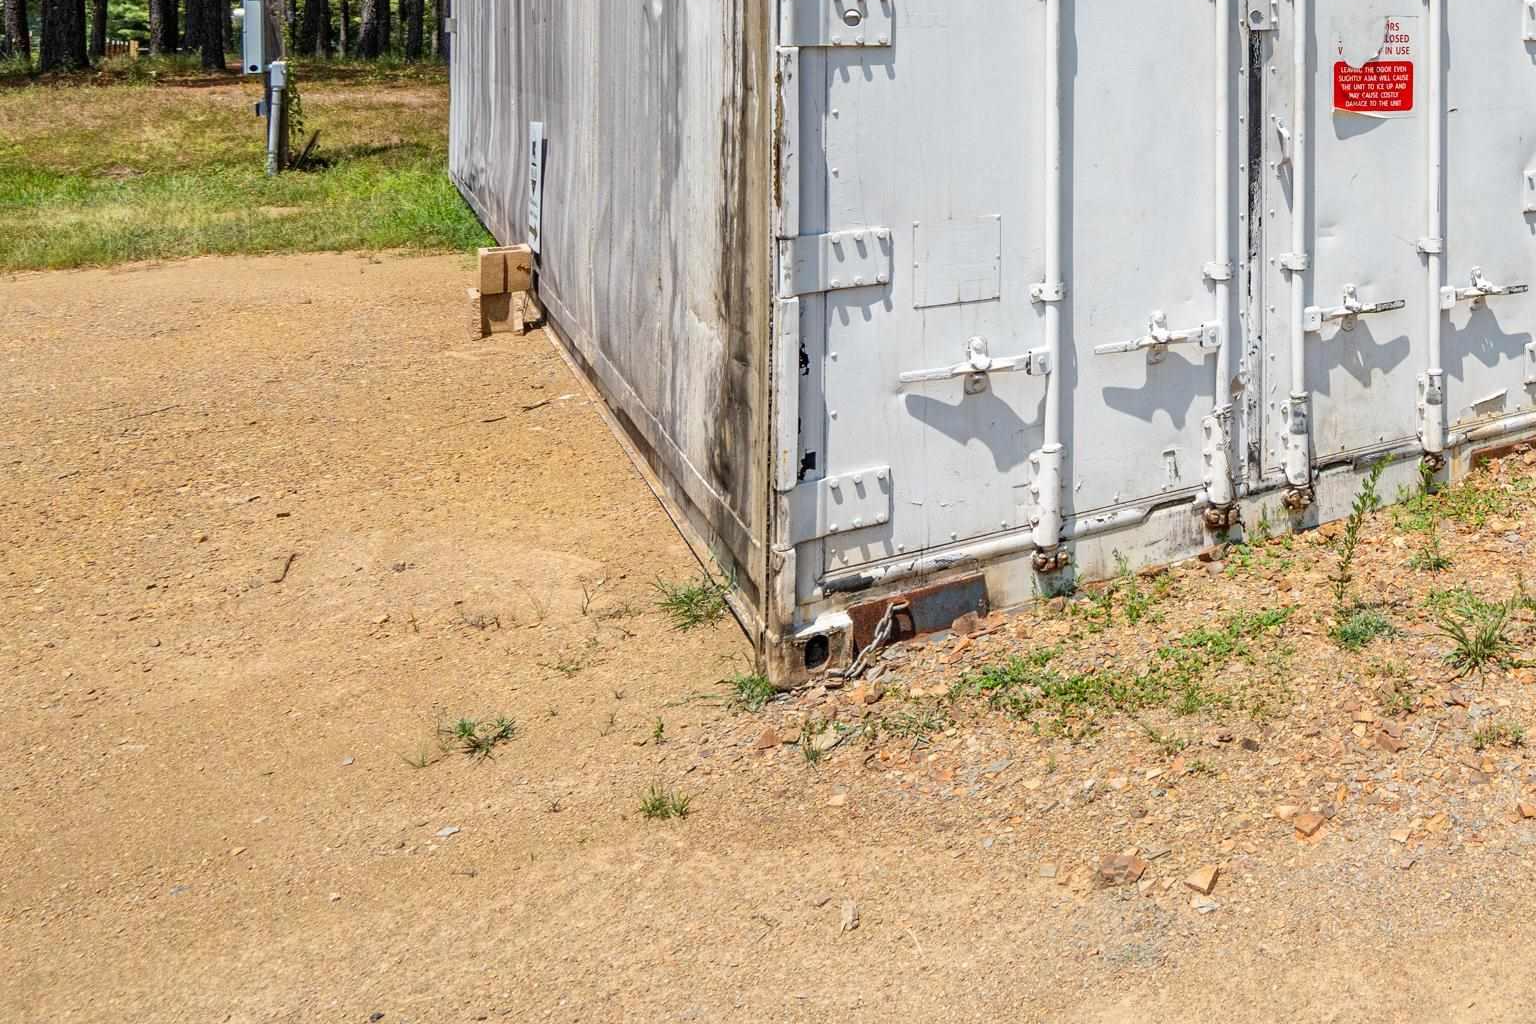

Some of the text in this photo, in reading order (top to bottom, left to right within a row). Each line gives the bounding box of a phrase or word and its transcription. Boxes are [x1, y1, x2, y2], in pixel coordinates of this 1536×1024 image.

[1384, 34, 1410, 43] LOSED
[1385, 46, 1410, 55] IN USE
[1341, 83, 1351, 91] THE
